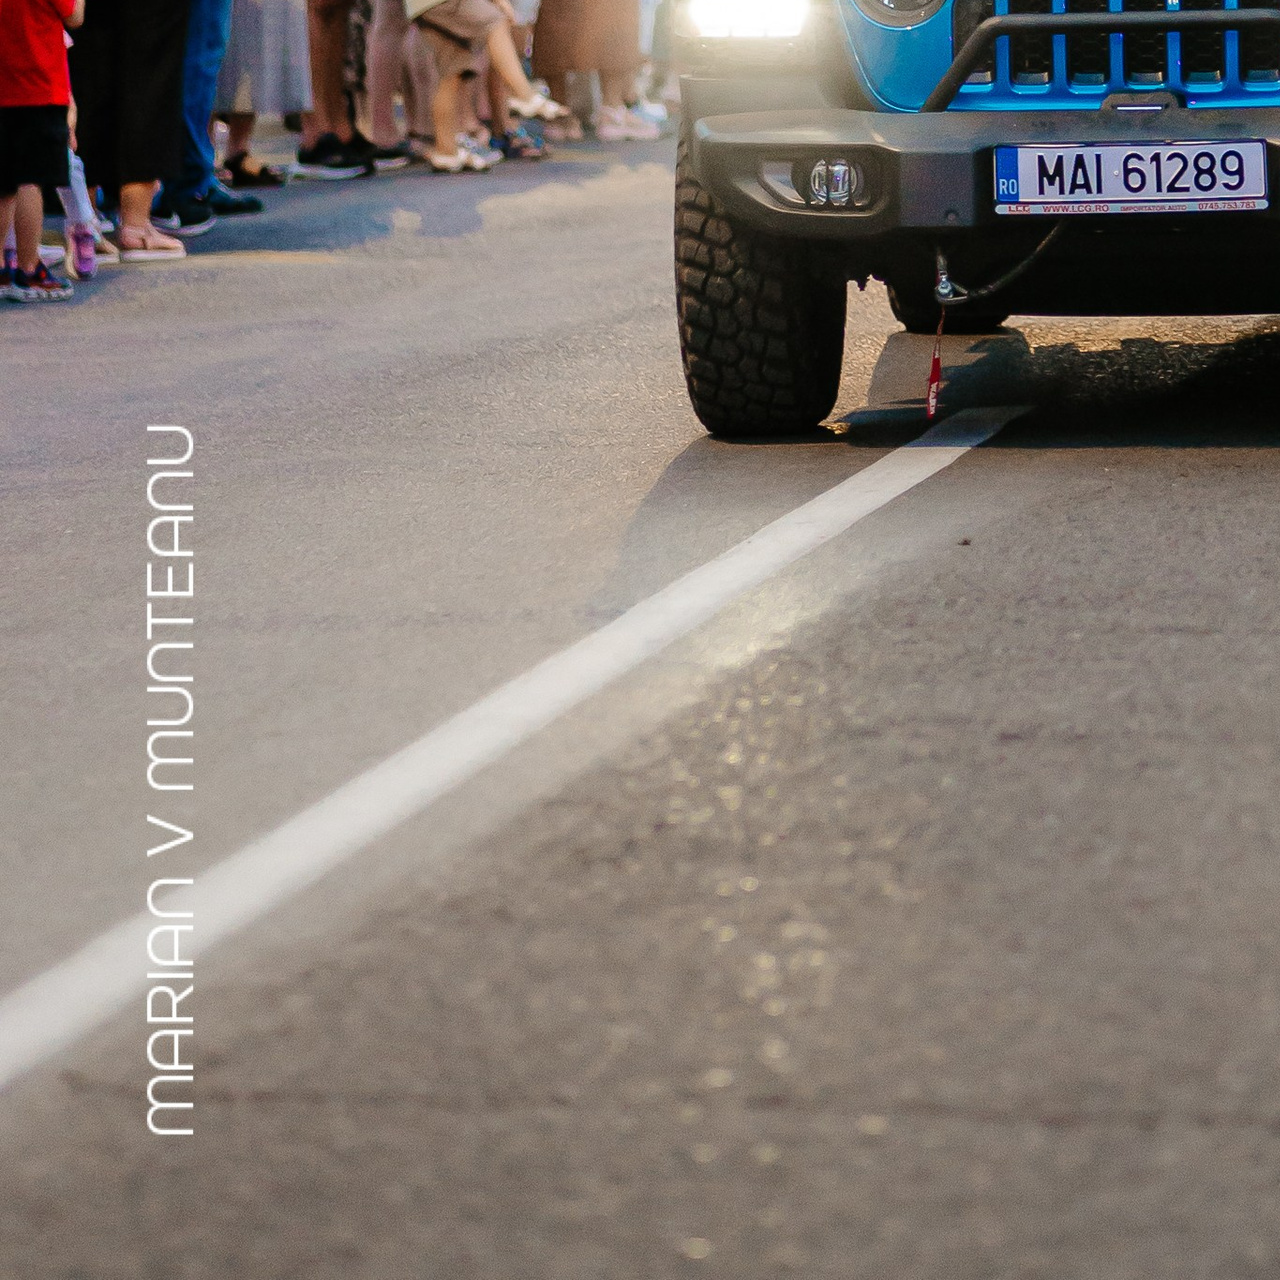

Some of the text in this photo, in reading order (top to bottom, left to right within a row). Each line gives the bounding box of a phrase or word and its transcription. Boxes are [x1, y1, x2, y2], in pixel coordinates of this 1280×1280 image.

[1037, 150, 1244, 196] MAI 61289
[999, 178, 1018, 195] RO
[1042, 204, 1109, 213] WWW.LCG.RO
